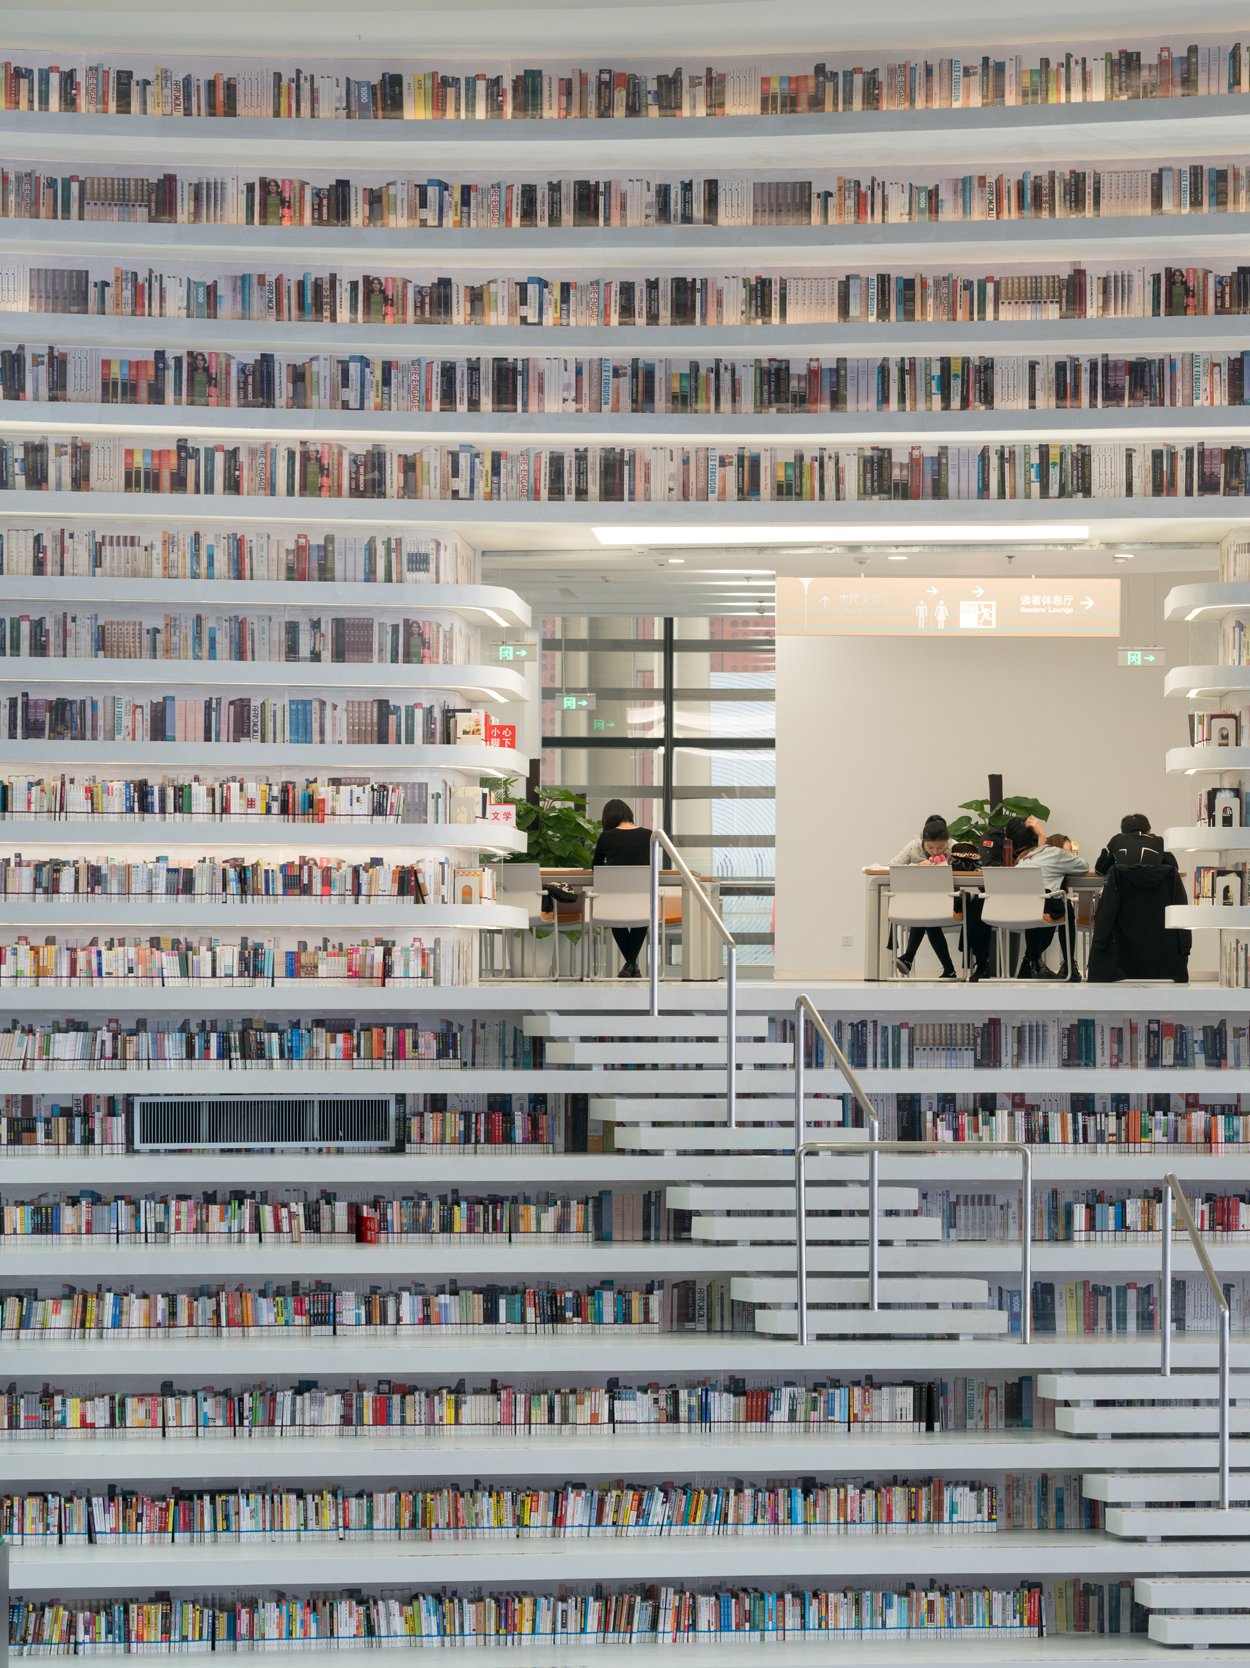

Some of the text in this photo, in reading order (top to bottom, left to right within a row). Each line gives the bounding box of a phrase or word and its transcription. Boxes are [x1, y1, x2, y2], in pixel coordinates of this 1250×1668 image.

[1048, 606, 1074, 614] Lounge
[490, 727, 512, 736] 小心
[492, 811, 512, 821] 文学
